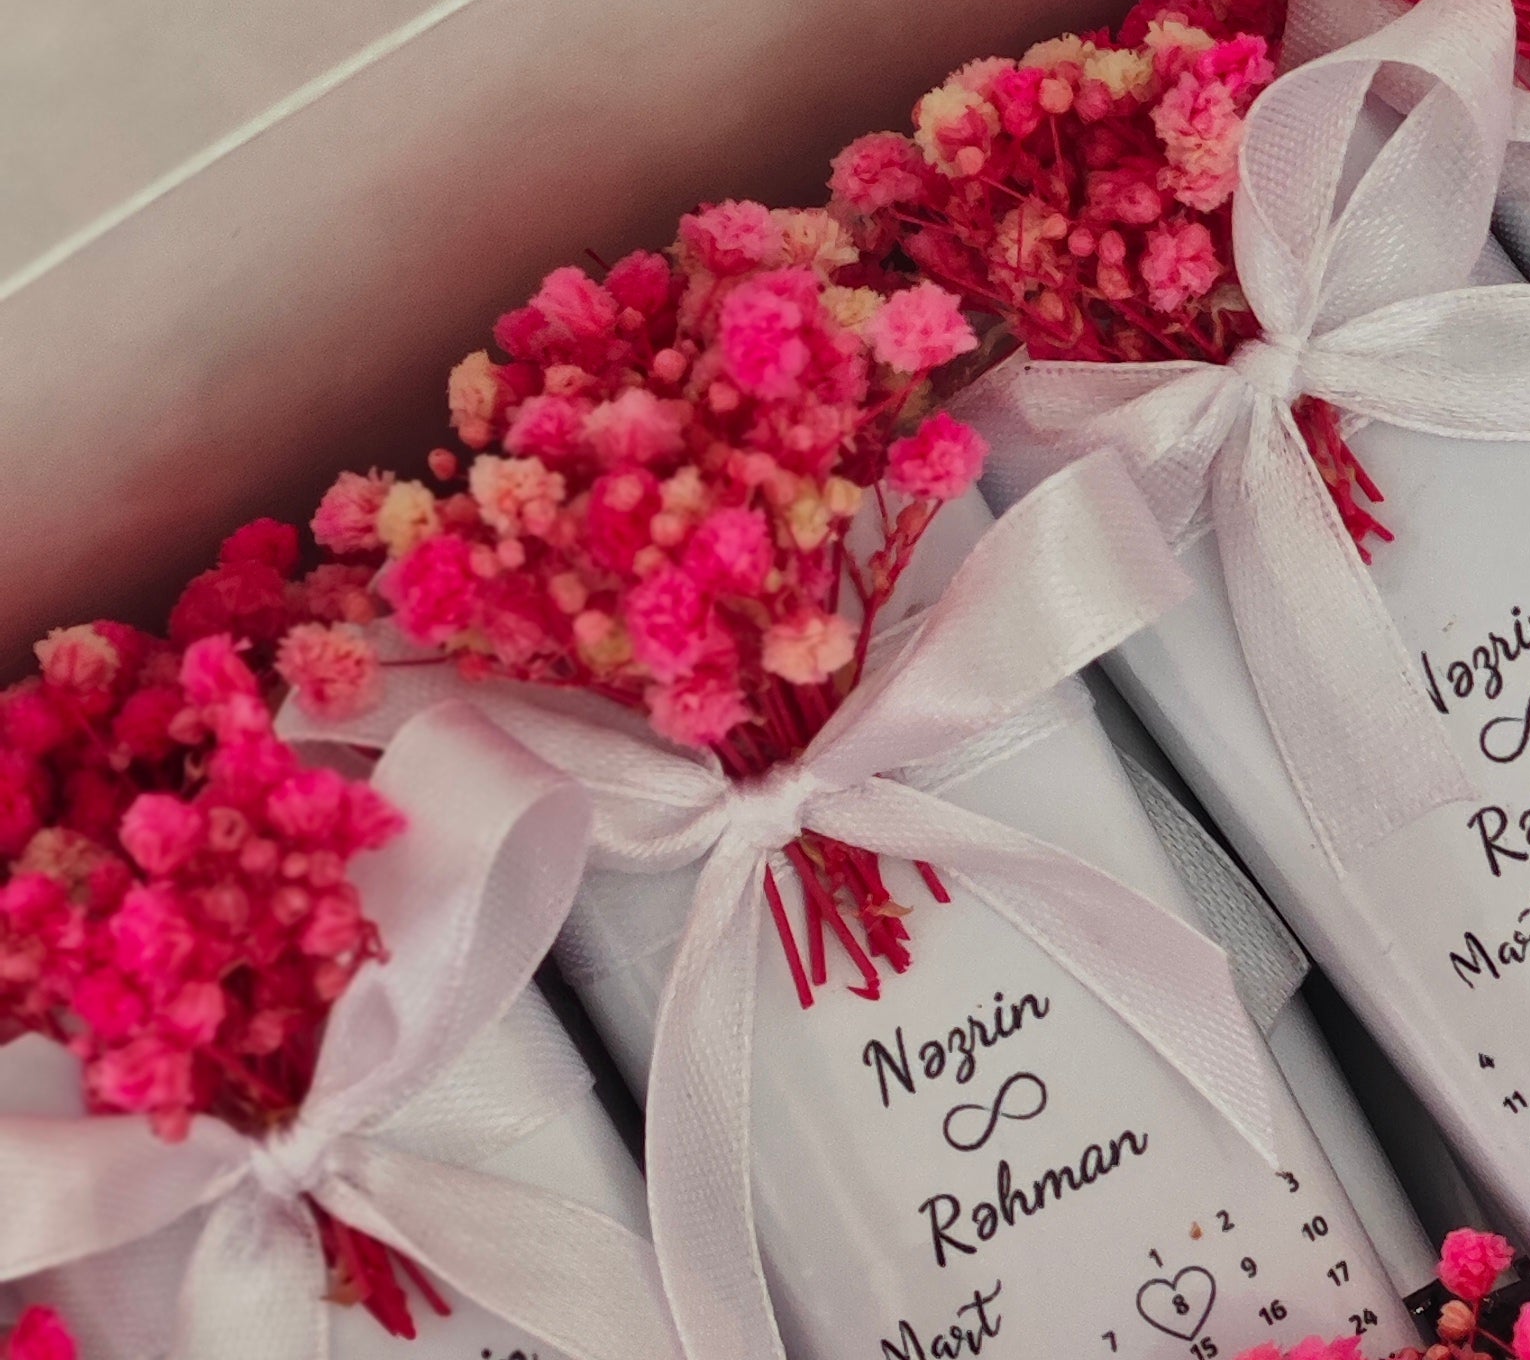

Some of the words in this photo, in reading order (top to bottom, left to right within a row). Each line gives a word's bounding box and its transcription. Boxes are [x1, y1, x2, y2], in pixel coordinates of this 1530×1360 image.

[862, 992, 1050, 1108] Nəzrin
[1478, 1053, 1495, 1069] 4
[1503, 1090, 1528, 1114] 11
[918, 1130, 1148, 1268] Rəhman
[1101, 1330, 1117, 1352] 7
[1172, 1294, 1190, 1315] 8
[1240, 1257, 1258, 1278] 9
[1301, 1216, 1328, 1242] 10
[1259, 1299, 1287, 1326] 16
[1327, 1260, 1349, 1287] 17
